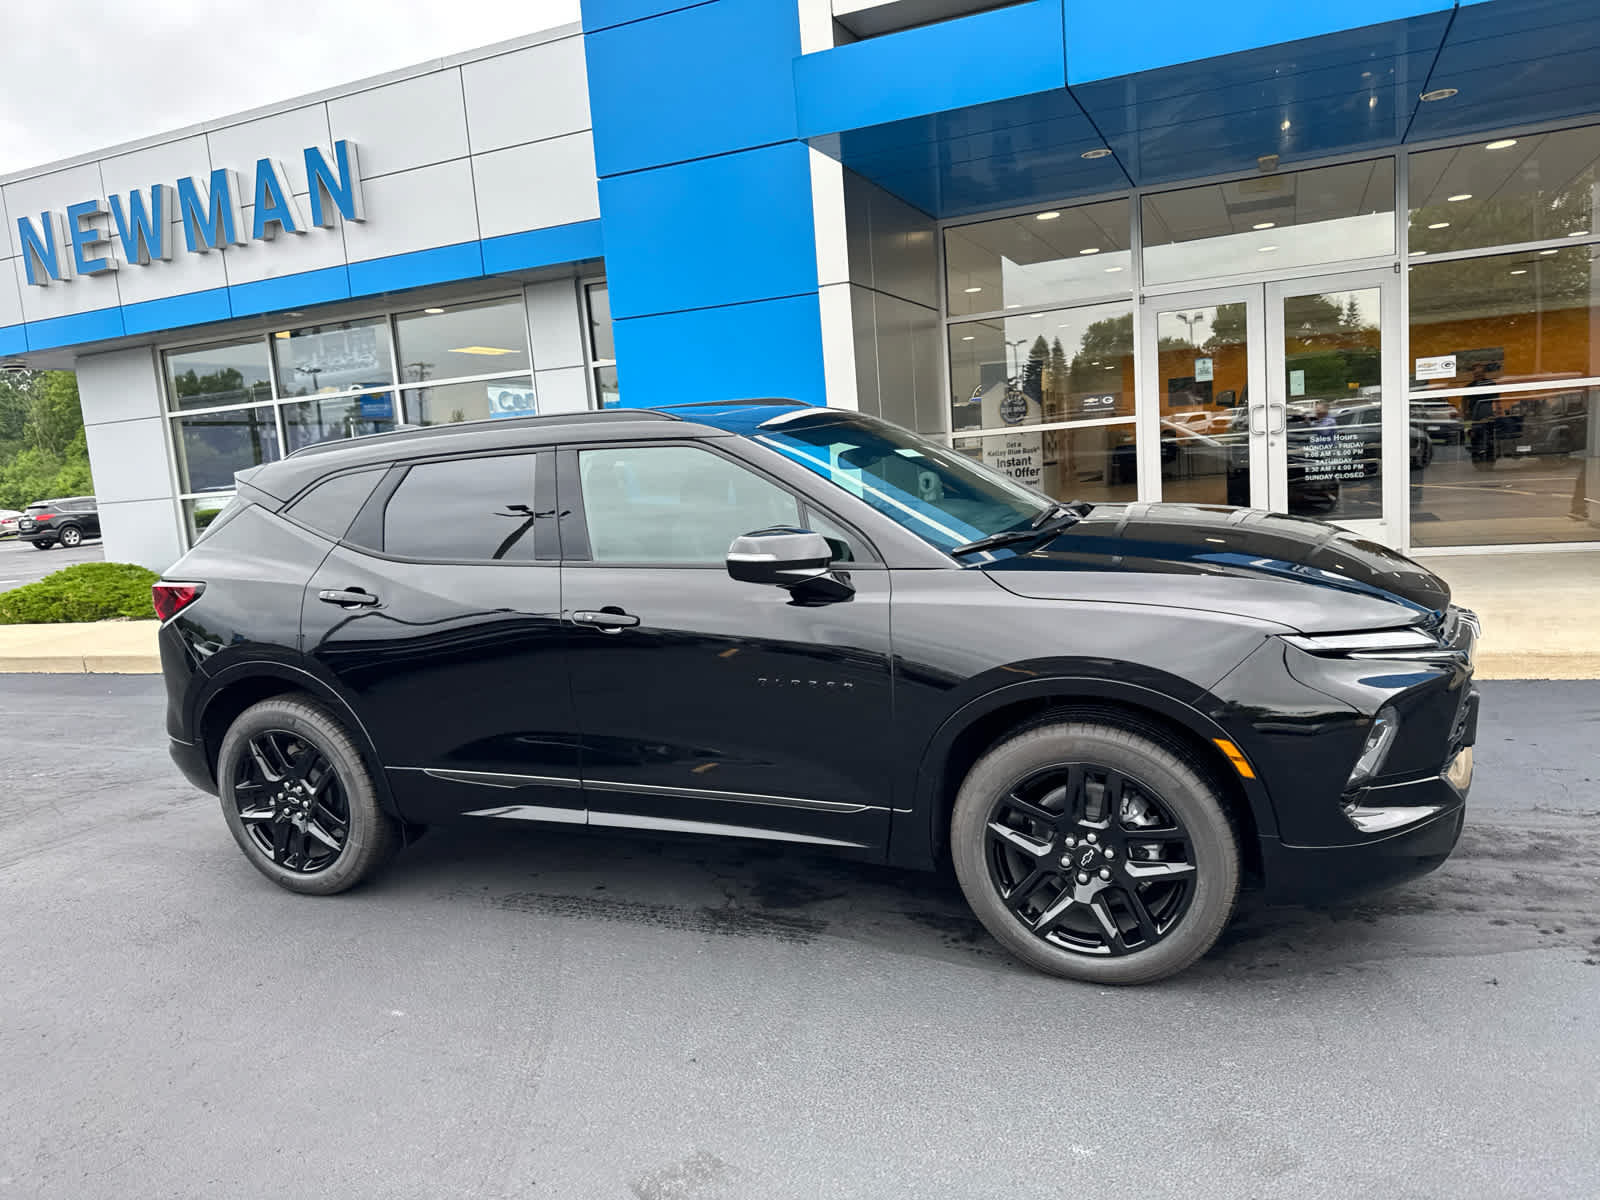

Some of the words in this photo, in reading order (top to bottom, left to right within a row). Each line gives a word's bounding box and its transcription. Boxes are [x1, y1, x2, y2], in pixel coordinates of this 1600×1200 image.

[17, 139, 366, 287] NEWMAN
[1310, 435, 1332, 443] Sales
[1333, 434, 1359, 442] Hours
[1338, 441, 1365, 449] FRIDAY
[996, 456, 1032, 468] Instant
[1315, 457, 1353, 465] SATURDAY
[1015, 466, 1040, 478] Offer
[1304, 473, 1334, 481] SUNDAY
[1334, 471, 1365, 479] CLOSED
